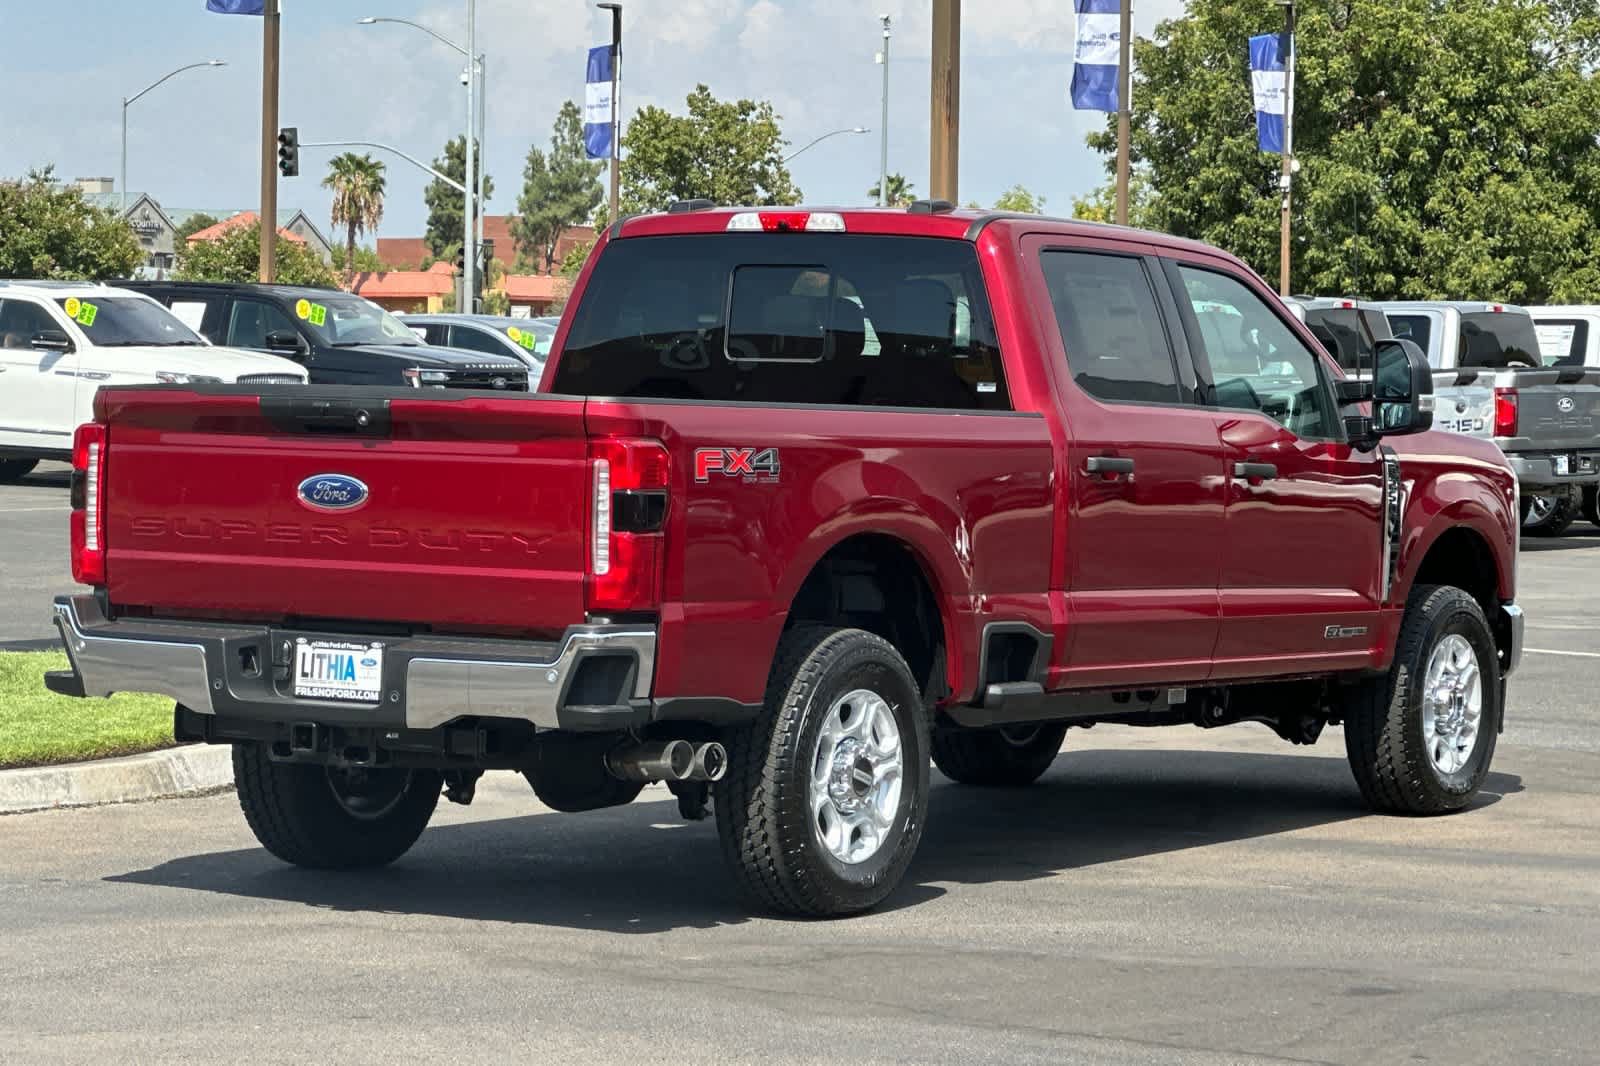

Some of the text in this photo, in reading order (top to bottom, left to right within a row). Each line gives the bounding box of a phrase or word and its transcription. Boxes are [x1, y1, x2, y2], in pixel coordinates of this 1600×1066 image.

[695, 447, 780, 484] FX4
[313, 480, 351, 501] Ford
[131, 516, 555, 554] SUPER DUTY
[300, 652, 356, 681] LITHIA
